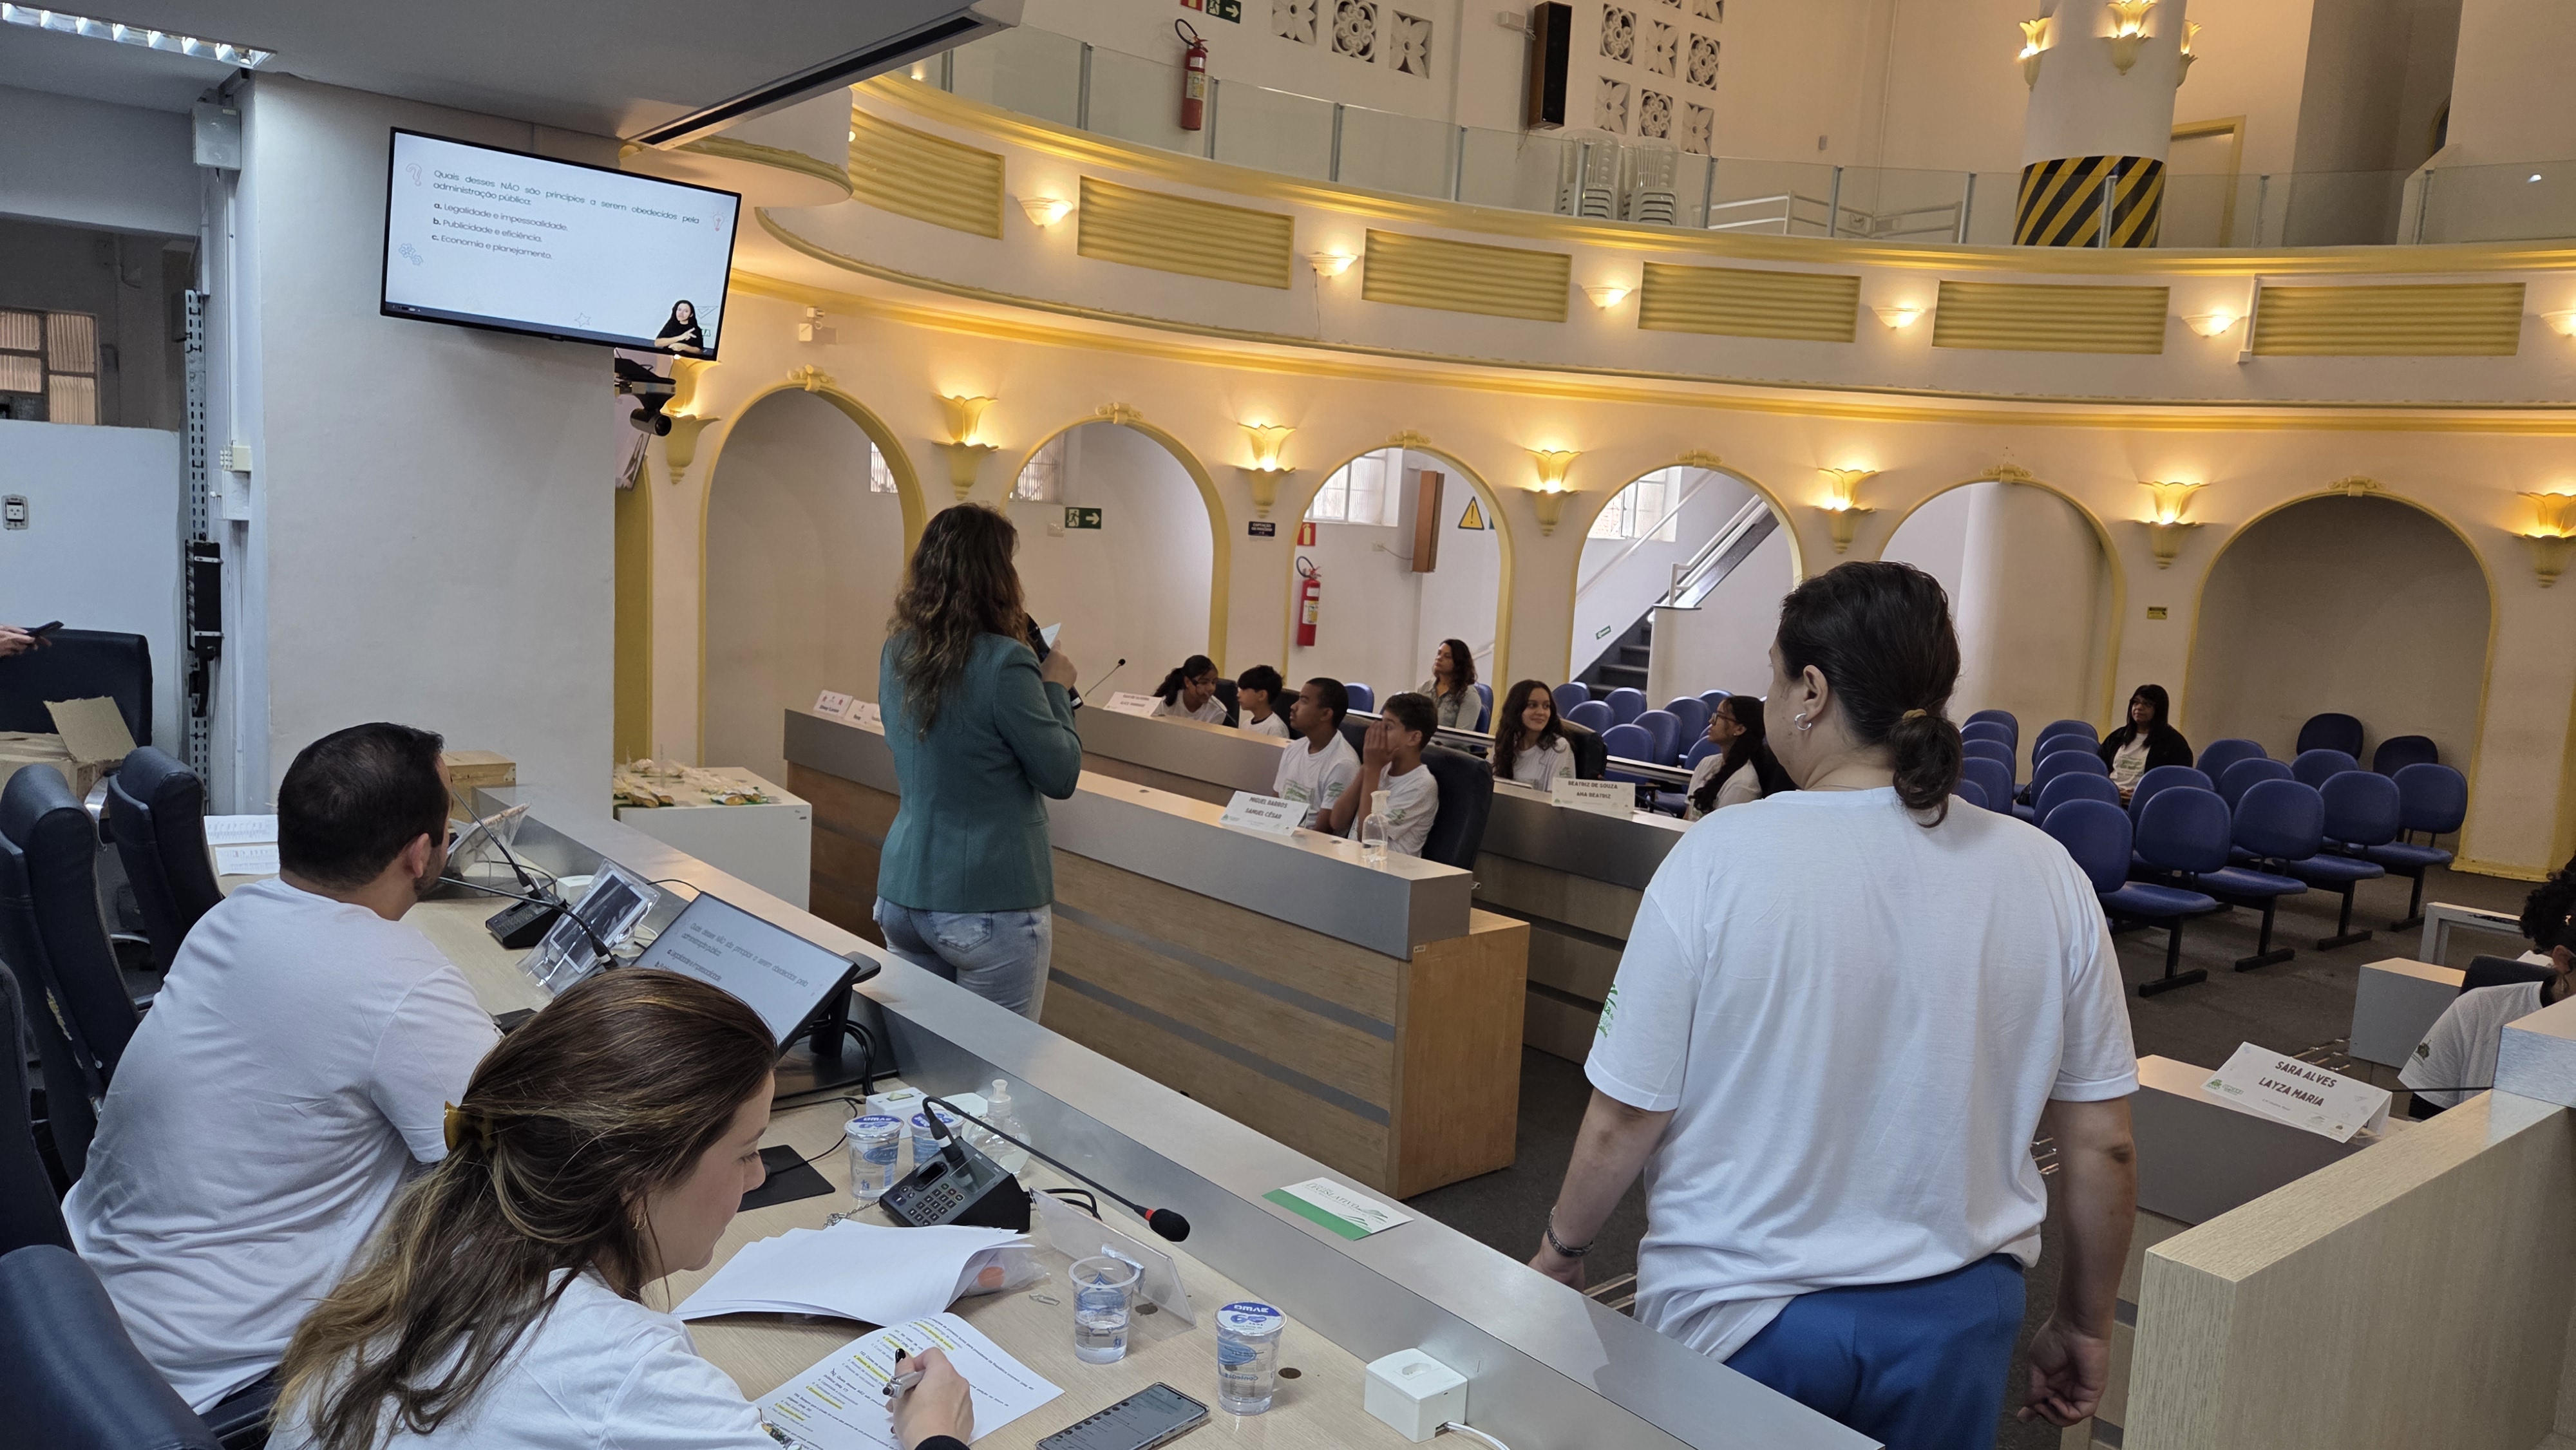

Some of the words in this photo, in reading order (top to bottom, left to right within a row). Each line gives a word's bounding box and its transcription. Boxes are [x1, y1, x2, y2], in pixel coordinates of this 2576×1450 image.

[433, 182, 497, 199] administração
[434, 170, 459, 181] Quais
[465, 176, 495, 187] desses
[500, 182, 520, 192] NÃO
[601, 201, 627, 211] serem
[632, 207, 677, 220] obedecidos
[682, 216, 699, 224] pela
[444, 203, 491, 218] Legalidade
[443, 219, 493, 234] Publicidade
[441, 235, 484, 249] Economia
[1249, 796, 1267, 805] MIGUEL
[1267, 799, 1288, 809] BARROS
[1245, 807, 1264, 816] SAMUEL
[1265, 810, 1282, 820] CÉSAR
[2275, 1060, 2304, 1077] SARA
[2302, 1071, 2338, 1088] ALVES
[2258, 1077, 2291, 1095] LAYZA
[2291, 1088, 2325, 1107] MARIA
[1234, 1304, 1269, 1313] DMAE
